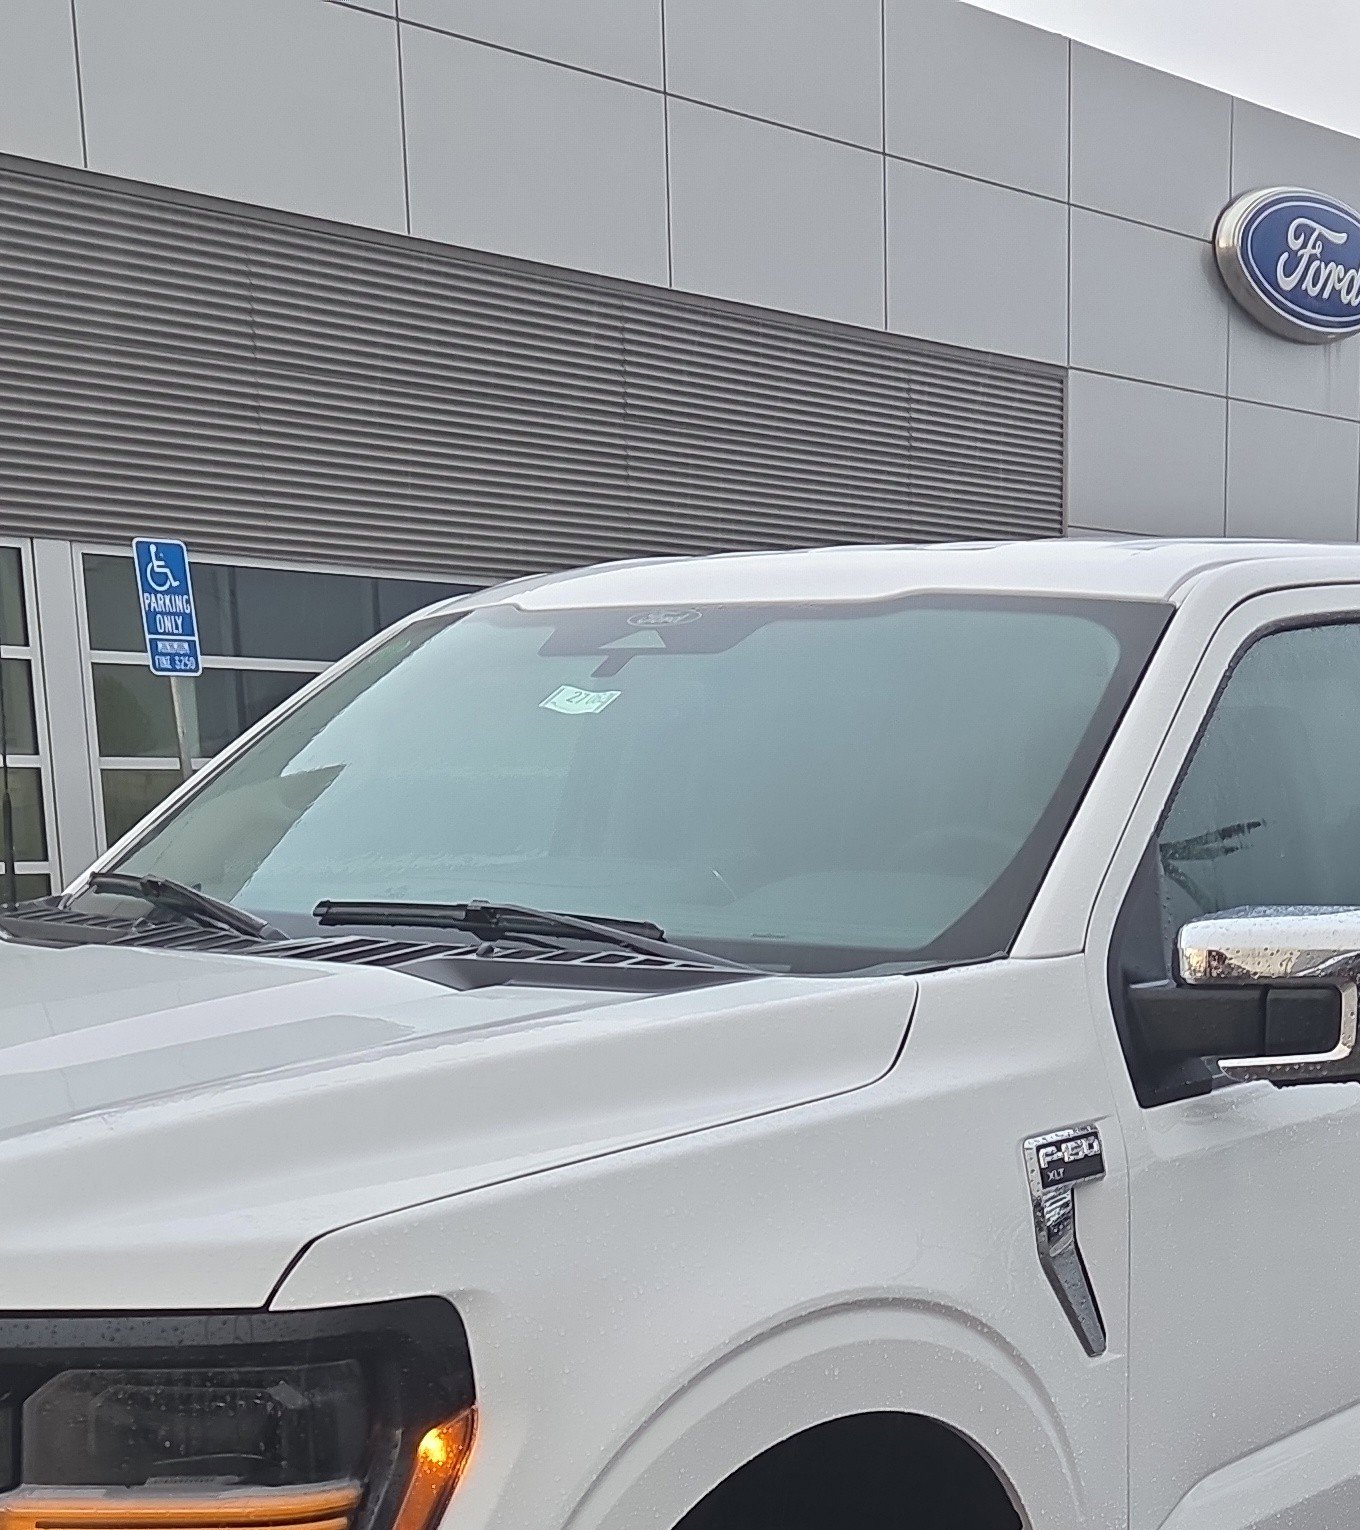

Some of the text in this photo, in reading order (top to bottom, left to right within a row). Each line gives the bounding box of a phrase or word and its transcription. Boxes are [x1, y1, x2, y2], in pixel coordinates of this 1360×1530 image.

[143, 592, 191, 614] PARKING
[155, 614, 183, 634] ONLY
[1047, 1168, 1065, 1182] XLT
